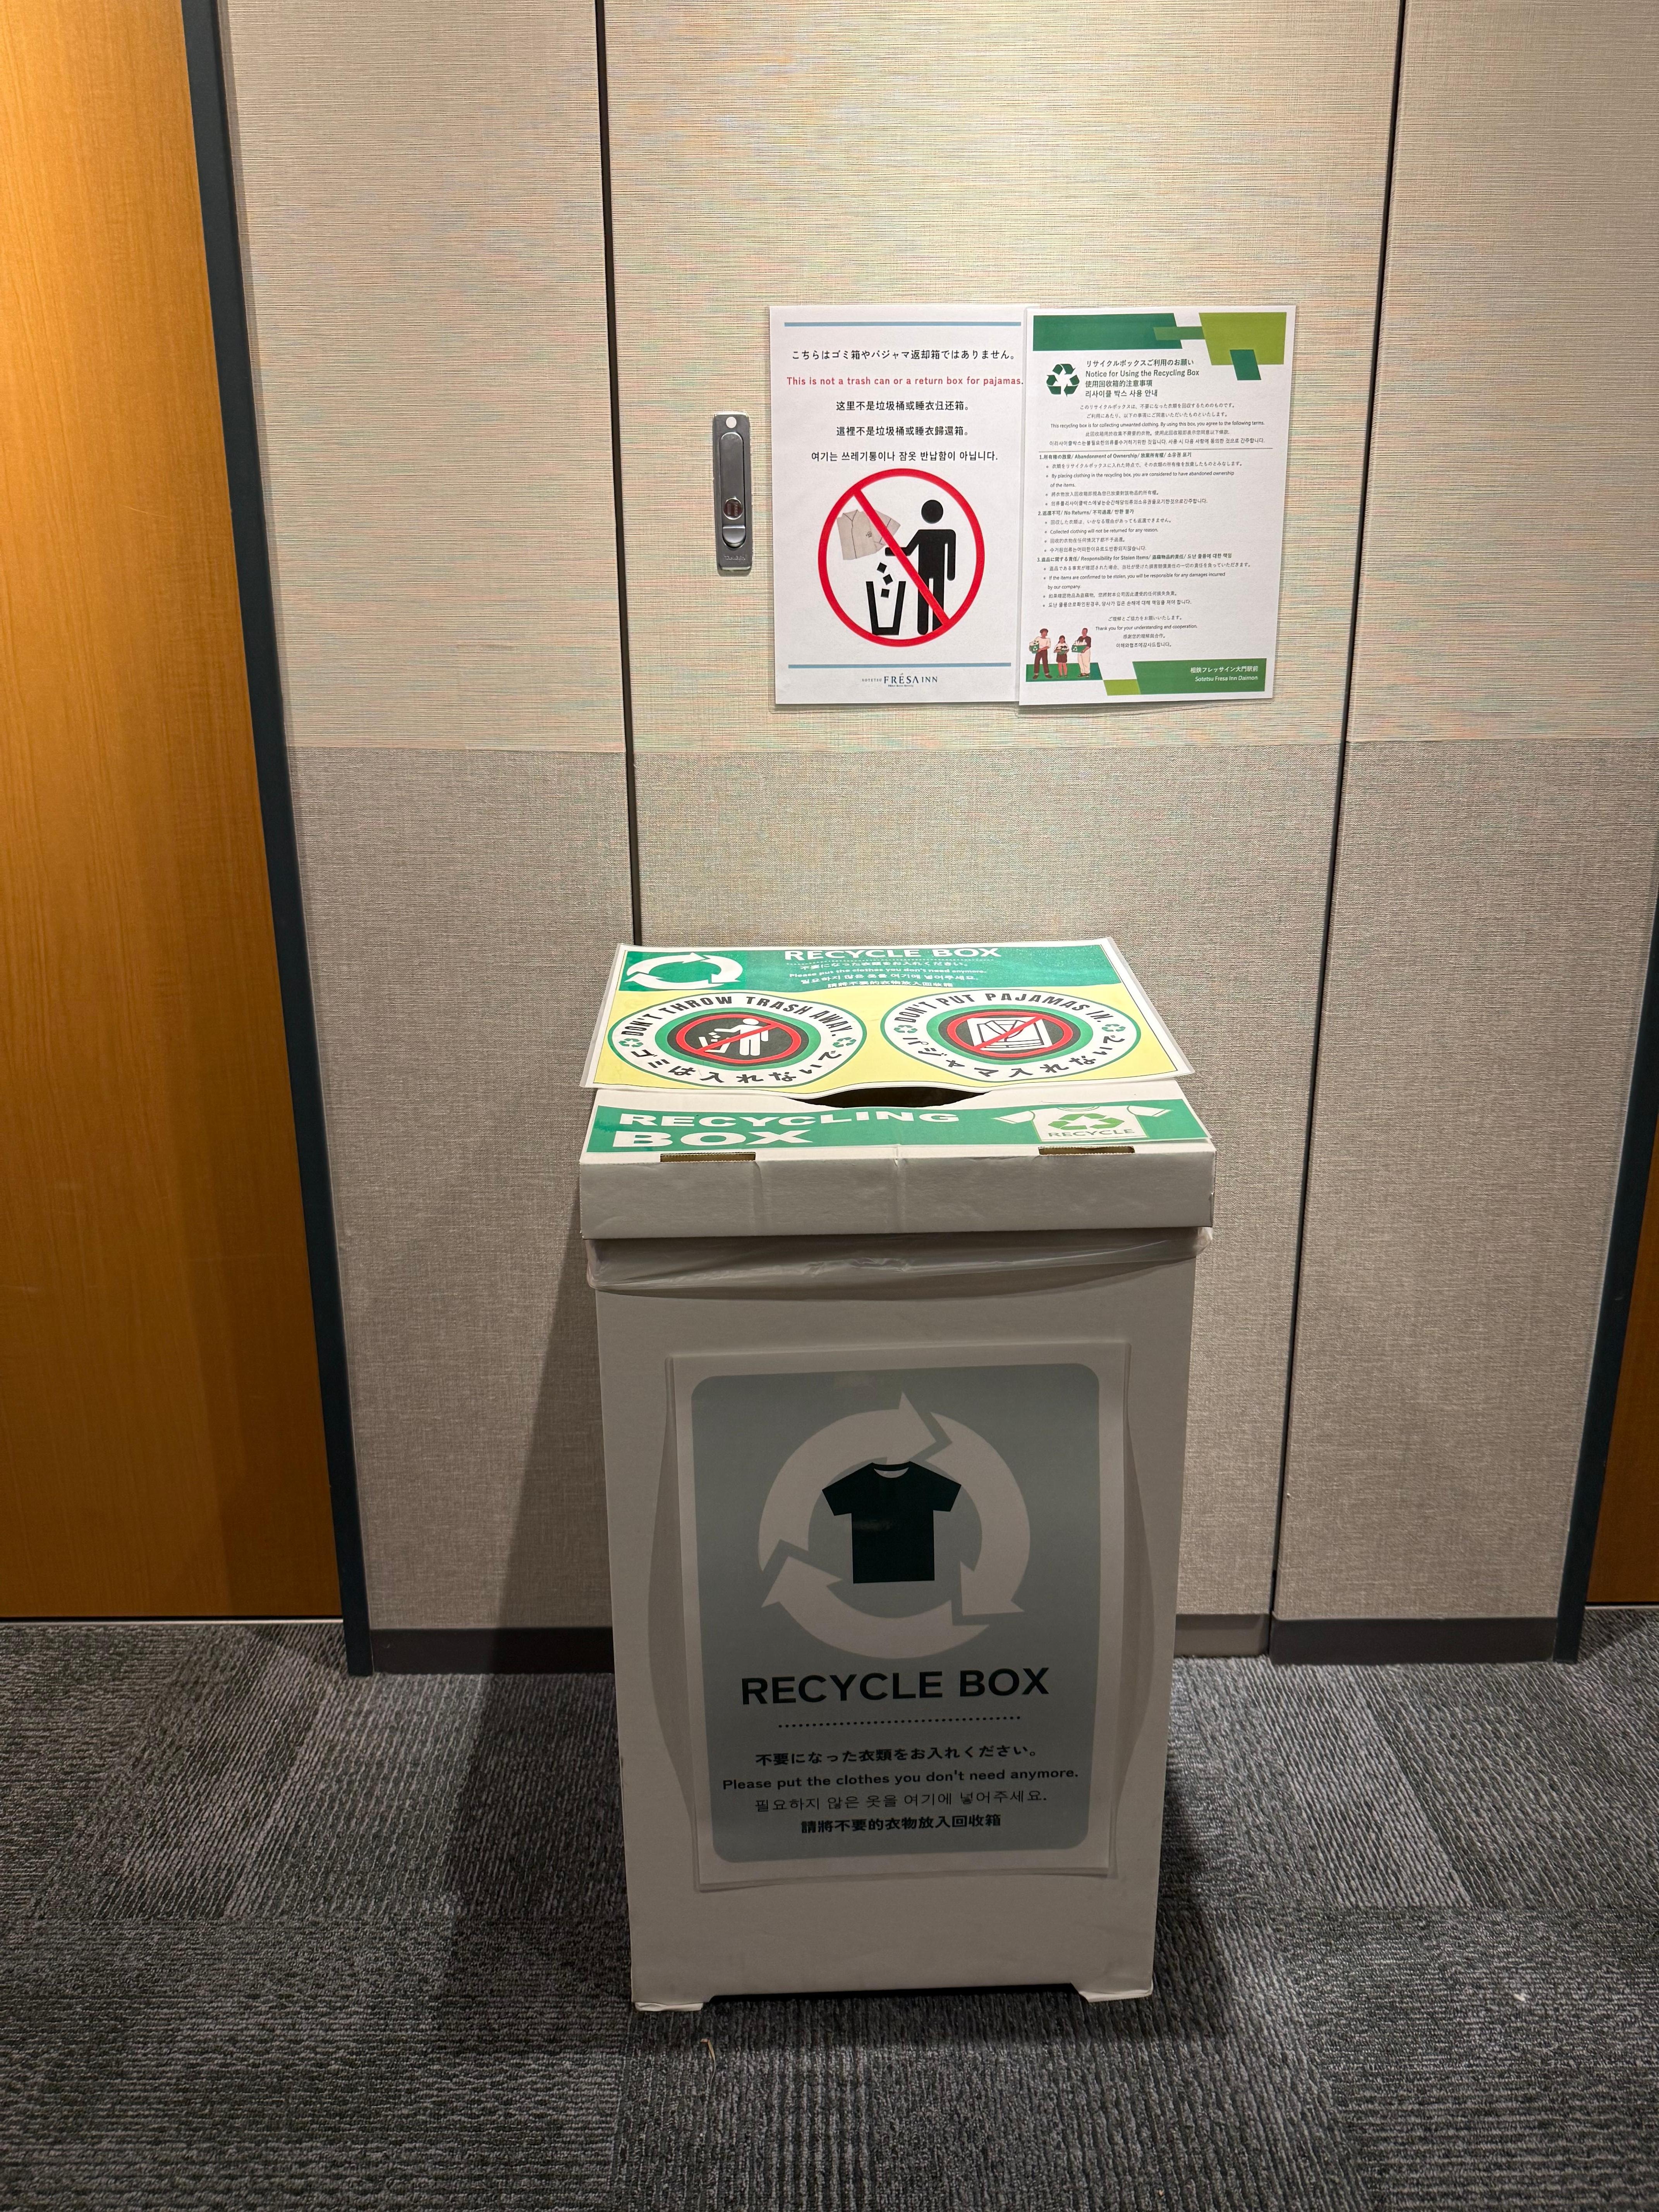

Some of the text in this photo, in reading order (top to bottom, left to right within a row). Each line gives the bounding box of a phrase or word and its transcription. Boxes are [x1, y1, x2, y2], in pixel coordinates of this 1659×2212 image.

[787, 376, 805, 385] This
[810, 376, 816, 385] is
[847, 376, 870, 385] trash
[947, 376, 962, 385] box
[967, 376, 980, 385] for
[984, 377, 1023, 386] pajamas.
[1120, 370, 1139, 378] Using
[1154, 369, 1185, 377] Recycling
[1085, 380, 1152, 388] 使用回收箱的注意事項
[1085, 390, 1111, 398] 리사이클
[1130, 389, 1142, 397] 사용
[836, 400, 968, 410] 这里不是垃圾桶或睡衣归还箱。
[837, 426, 967, 436] 這裡不是垃圾桶或睡衣歸還箱。
[812, 451, 997, 462] 여기는 쓰레기통이나 잠옷 반납함이 아닙니다.
[785, 948, 1001, 961] RECYCLE BOX
[894, 993, 1114, 1022] DON'T PUT PAJAMAS IN.
[621, 996, 852, 1036] DON'T THROW TRASH AWAY.
[903, 1036, 1125, 1077] パジャマ入れないで
[630, 1049, 842, 1084] ゴミは入れないで
[620, 1111, 959, 1127] RECYCLING
[613, 1130, 813, 1147] BOX
[1048, 1129, 1135, 1137] RECYCLE
[742, 1668, 1049, 1705] RECYCLE BOX
[756, 1745, 1036, 1767] 不要になった衣類をお入れください。
[724, 1768, 1079, 1790] Please put the clothes you don't need anymore.
[756, 1791, 1047, 1812] 필요하지 않은 옷을 여기에 넣어주세요.
[802, 1814, 1001, 1834] 請將不要的衣物放入回收箱
